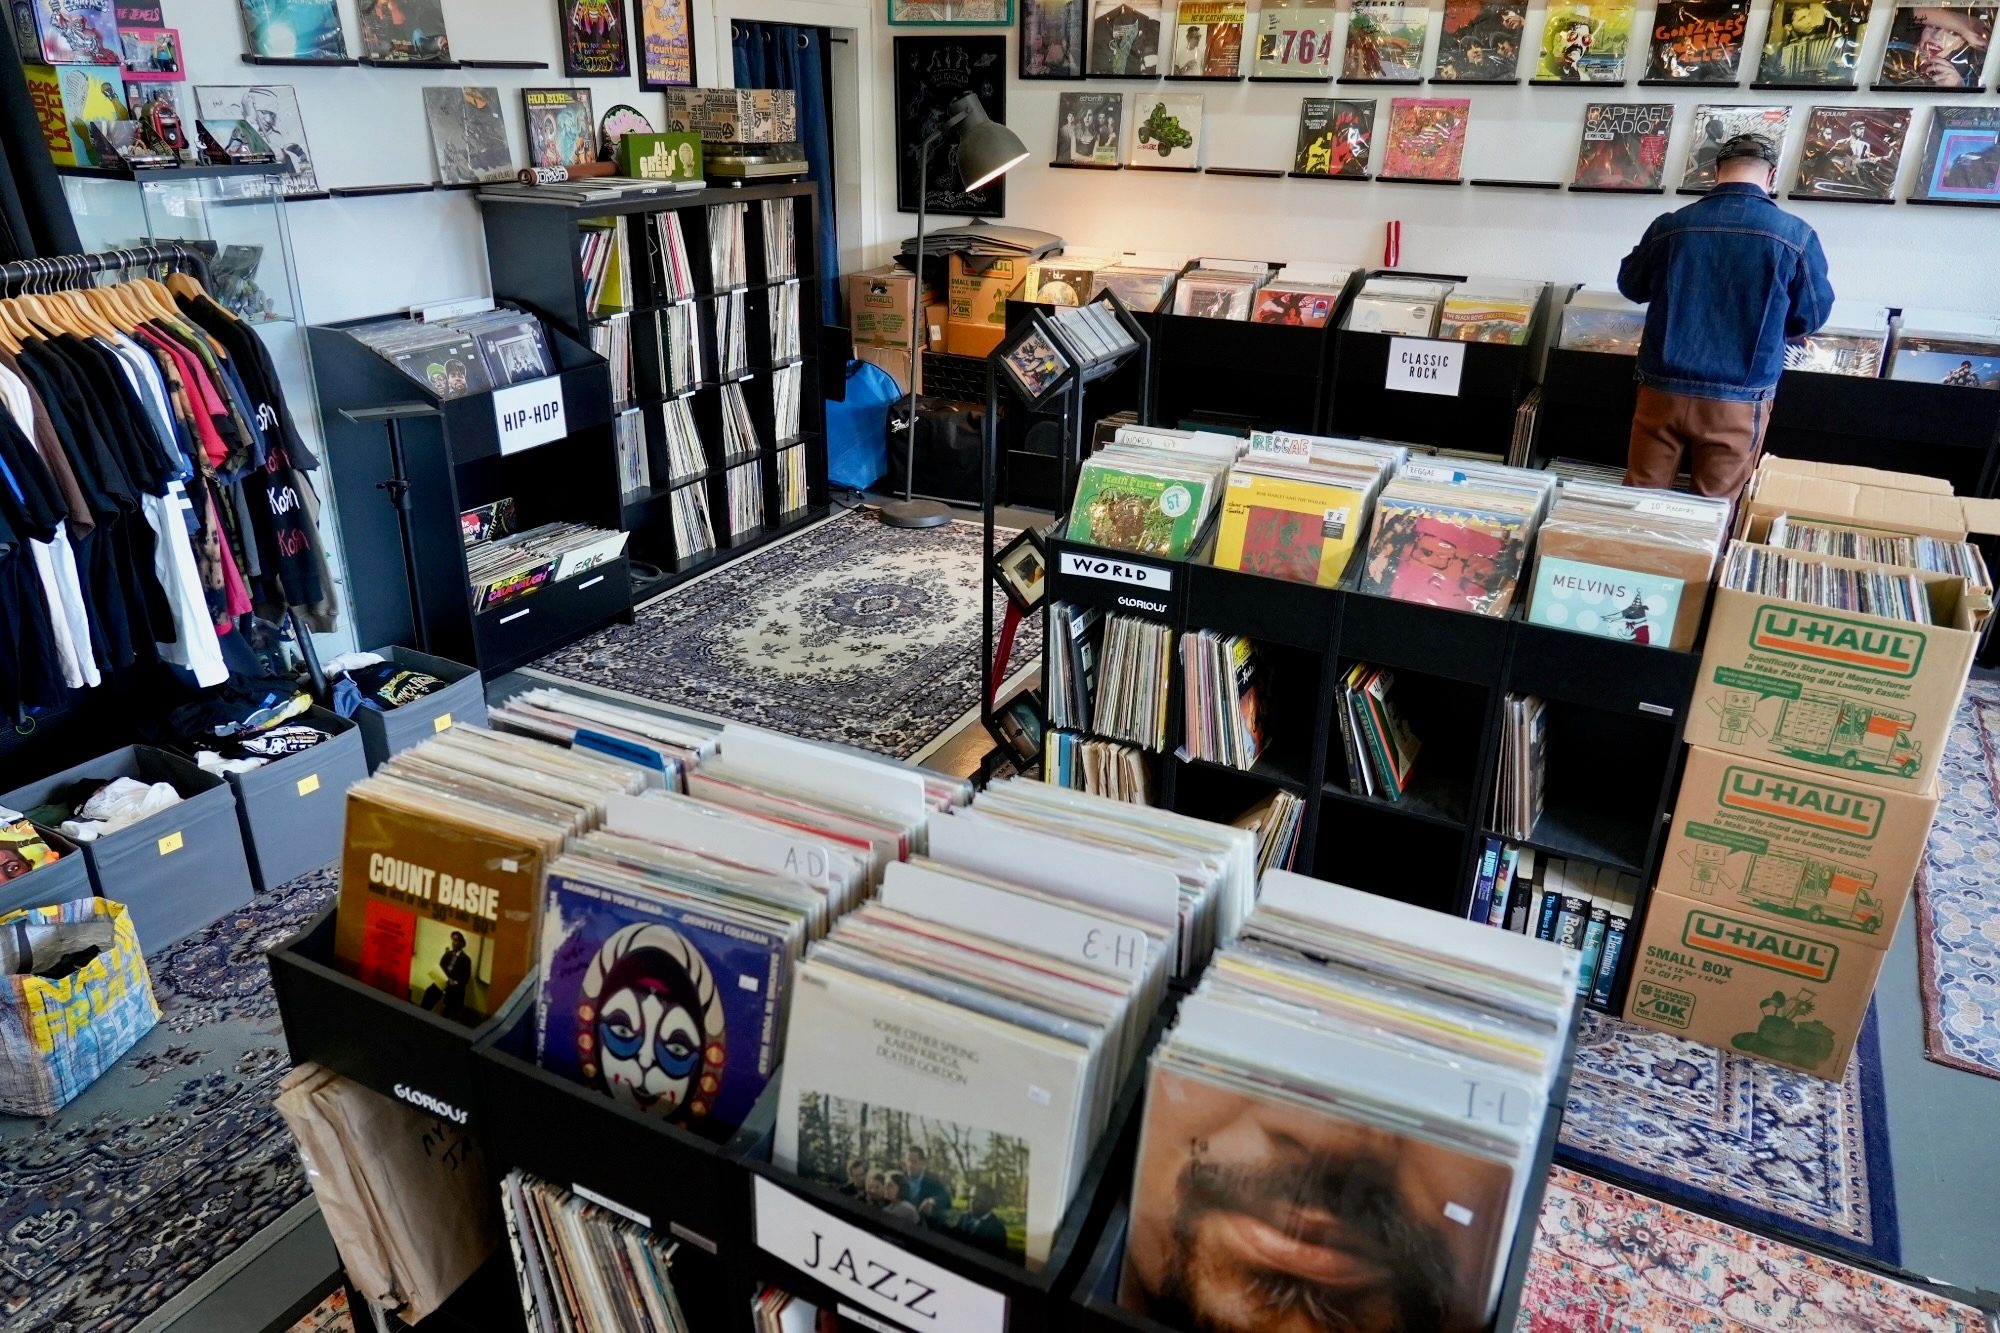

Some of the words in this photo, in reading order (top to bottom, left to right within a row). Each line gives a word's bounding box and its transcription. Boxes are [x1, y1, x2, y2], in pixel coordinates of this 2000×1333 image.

[1191, 14, 1204, 22] NEW
[1205, 14, 1244, 22] CATHEDRALS
[1655, 15, 1745, 40] GONZALES
[1281, 30, 1332, 65] 764
[43, 82, 73, 153] LAZER
[1585, 120, 1652, 134] SAADIQ
[1588, 107, 1673, 122] RAPHAEL
[958, 306, 971, 314] OK
[1402, 352, 1449, 368] CLASSIC
[1409, 366, 1438, 380] ROCK
[503, 401, 560, 432] HIP-HOP
[1409, 466, 1436, 477] REGGAE
[1073, 557, 1147, 582] WORLD
[1552, 573, 1626, 598] MELVINS
[1117, 595, 1168, 612] GLORIOUS
[1764, 613, 1912, 660] U-HAUL
[1743, 662, 1753, 670] to
[1755, 664, 1779, 675] Make
[1780, 669, 1817, 683] Packing
[1817, 677, 1835, 687] and
[1836, 680, 1873, 694] Loading
[1747, 653, 1799, 670] Specifically
[1799, 663, 1826, 675] Sized
[1827, 670, 1845, 680] and
[1846, 673, 1912, 691] Manufactured
[1732, 773, 1871, 822] U-HAUL
[1713, 817, 1723, 826] to
[1724, 820, 1748, 832] Make
[1749, 825, 1783, 841] Packing
[1783, 833, 1801, 844] and
[1802, 836, 1837, 853] Loading
[1716, 809, 1767, 827] Specifically
[1766, 819, 1793, 831] Sized
[1792, 827, 1810, 837] and
[1811, 829, 1873, 851] Manufactured
[369, 852, 436, 900] COUNT
[438, 872, 500, 922] BASIE
[1547, 895, 1556, 909] The
[681, 913, 723, 933] ORNETTE
[724, 925, 769, 945] COLEMAN
[1542, 909, 1554, 930] Blues
[1695, 918, 1825, 966] U-HAUL
[1646, 945, 1697, 968] SMALL
[1701, 960, 1734, 979] BOX
[1657, 970, 1671, 979] CU
[1671, 974, 1685, 983] FT
[1635, 1007, 1651, 1016] FOR
[1651, 1012, 1685, 1026] SHIPPING
[1654, 1000, 1687, 1020] OK
[873, 1018, 902, 1036] SOME
[902, 1029, 940, 1048] OTHER
[940, 1041, 980, 1063] SPRING
[876, 1044, 916, 1066] DEXTER
[917, 1061, 968, 1086] GORDON
[393, 1083, 470, 1125] GLORIOUS
[803, 1231, 937, 1320] JAZZ
